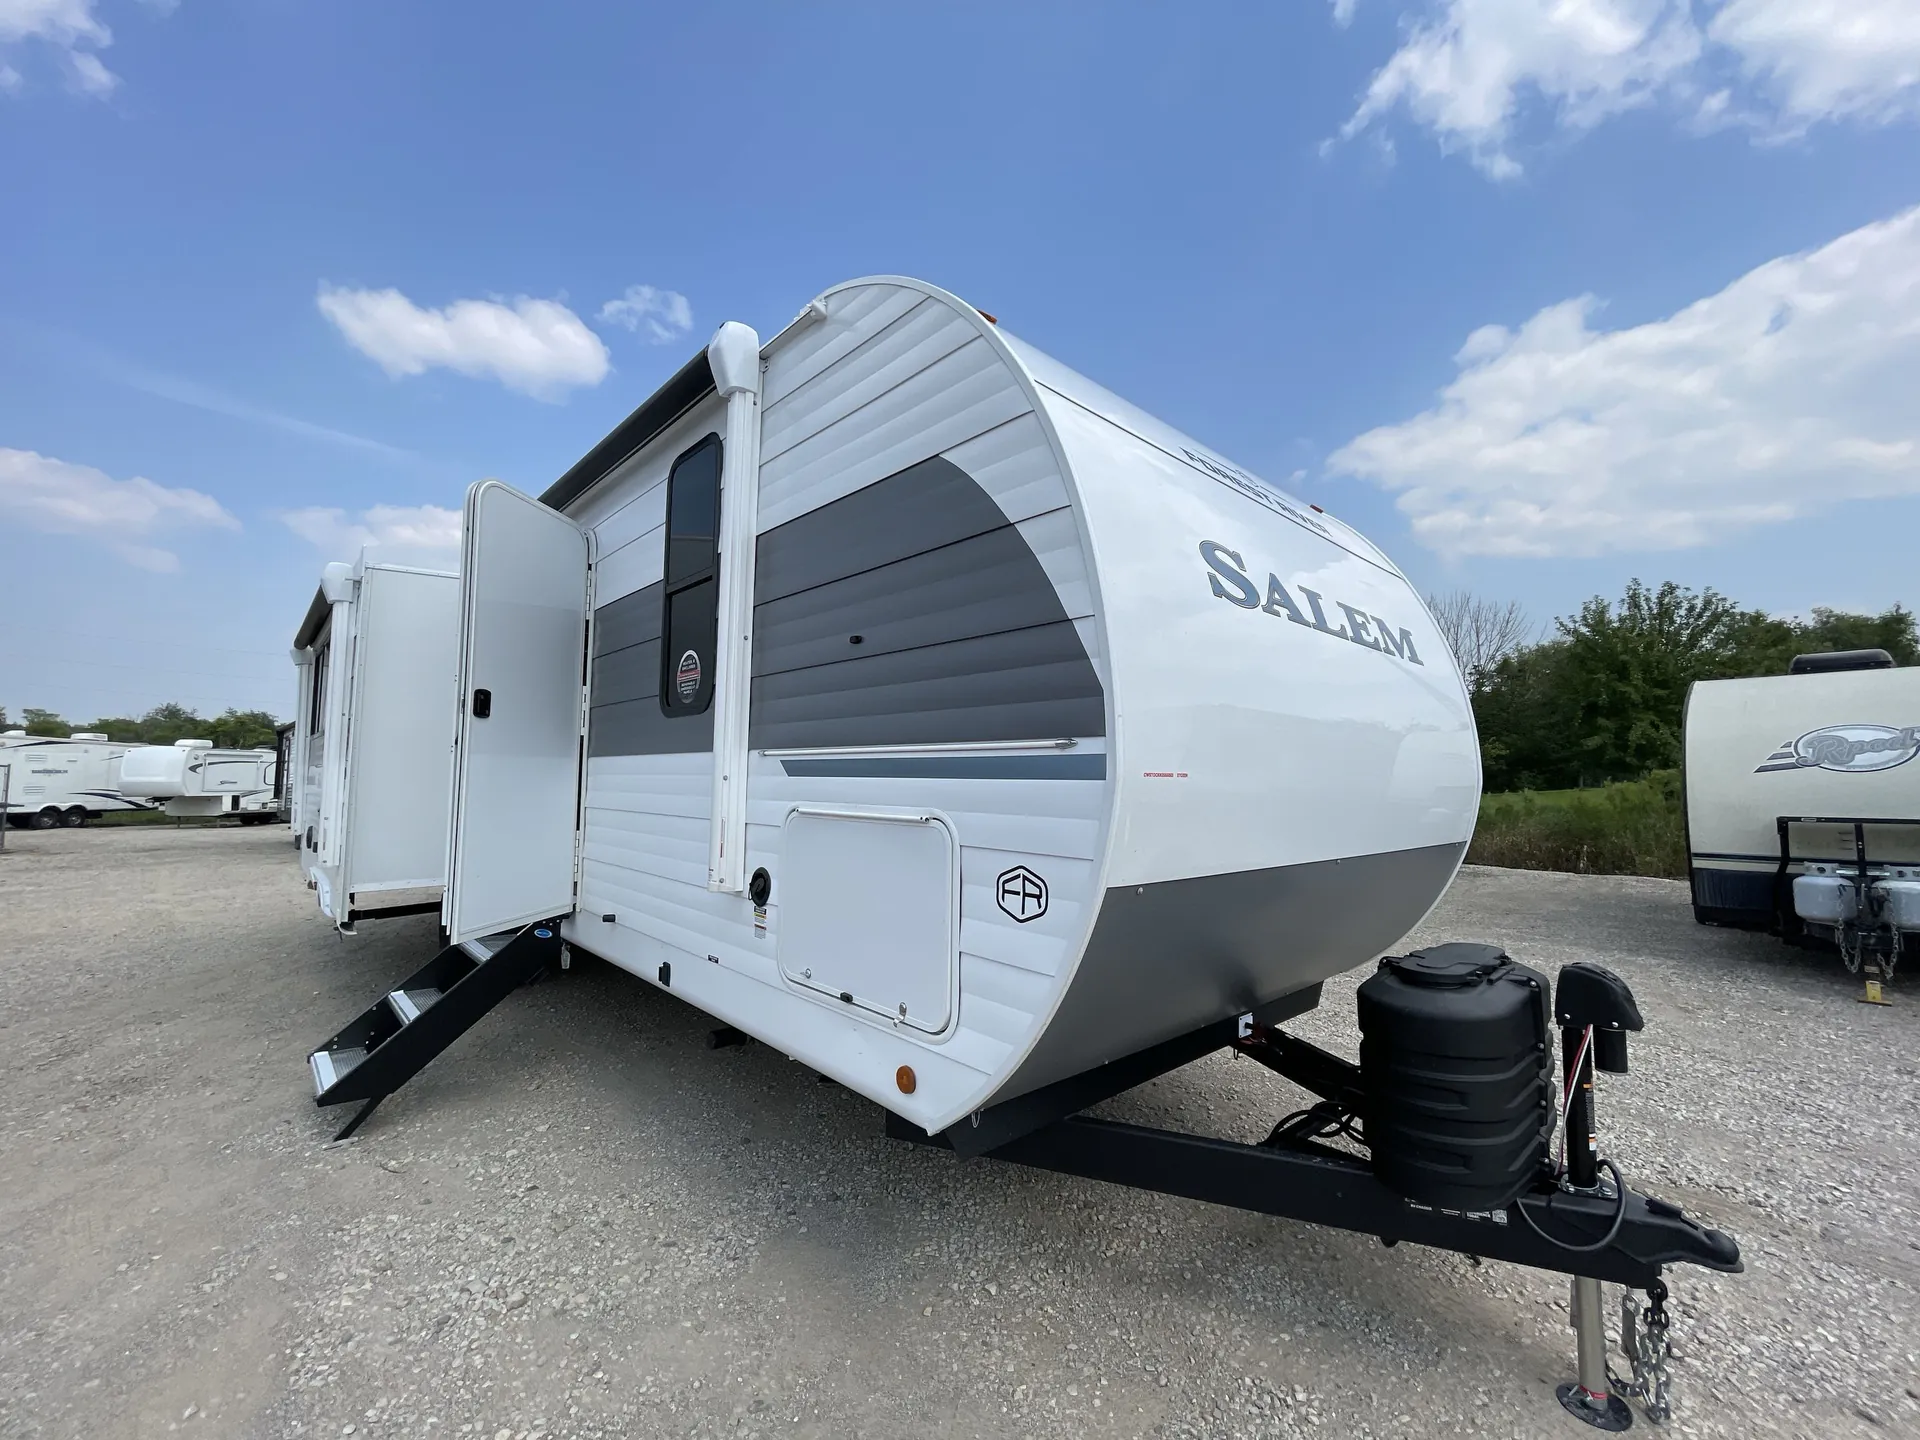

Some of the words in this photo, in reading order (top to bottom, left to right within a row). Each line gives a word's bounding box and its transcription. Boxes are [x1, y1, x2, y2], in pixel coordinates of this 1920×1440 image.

[1179, 446, 1273, 505] FOREST
[1273, 499, 1333, 538] RIVER
[1199, 540, 1424, 666] SALEM
